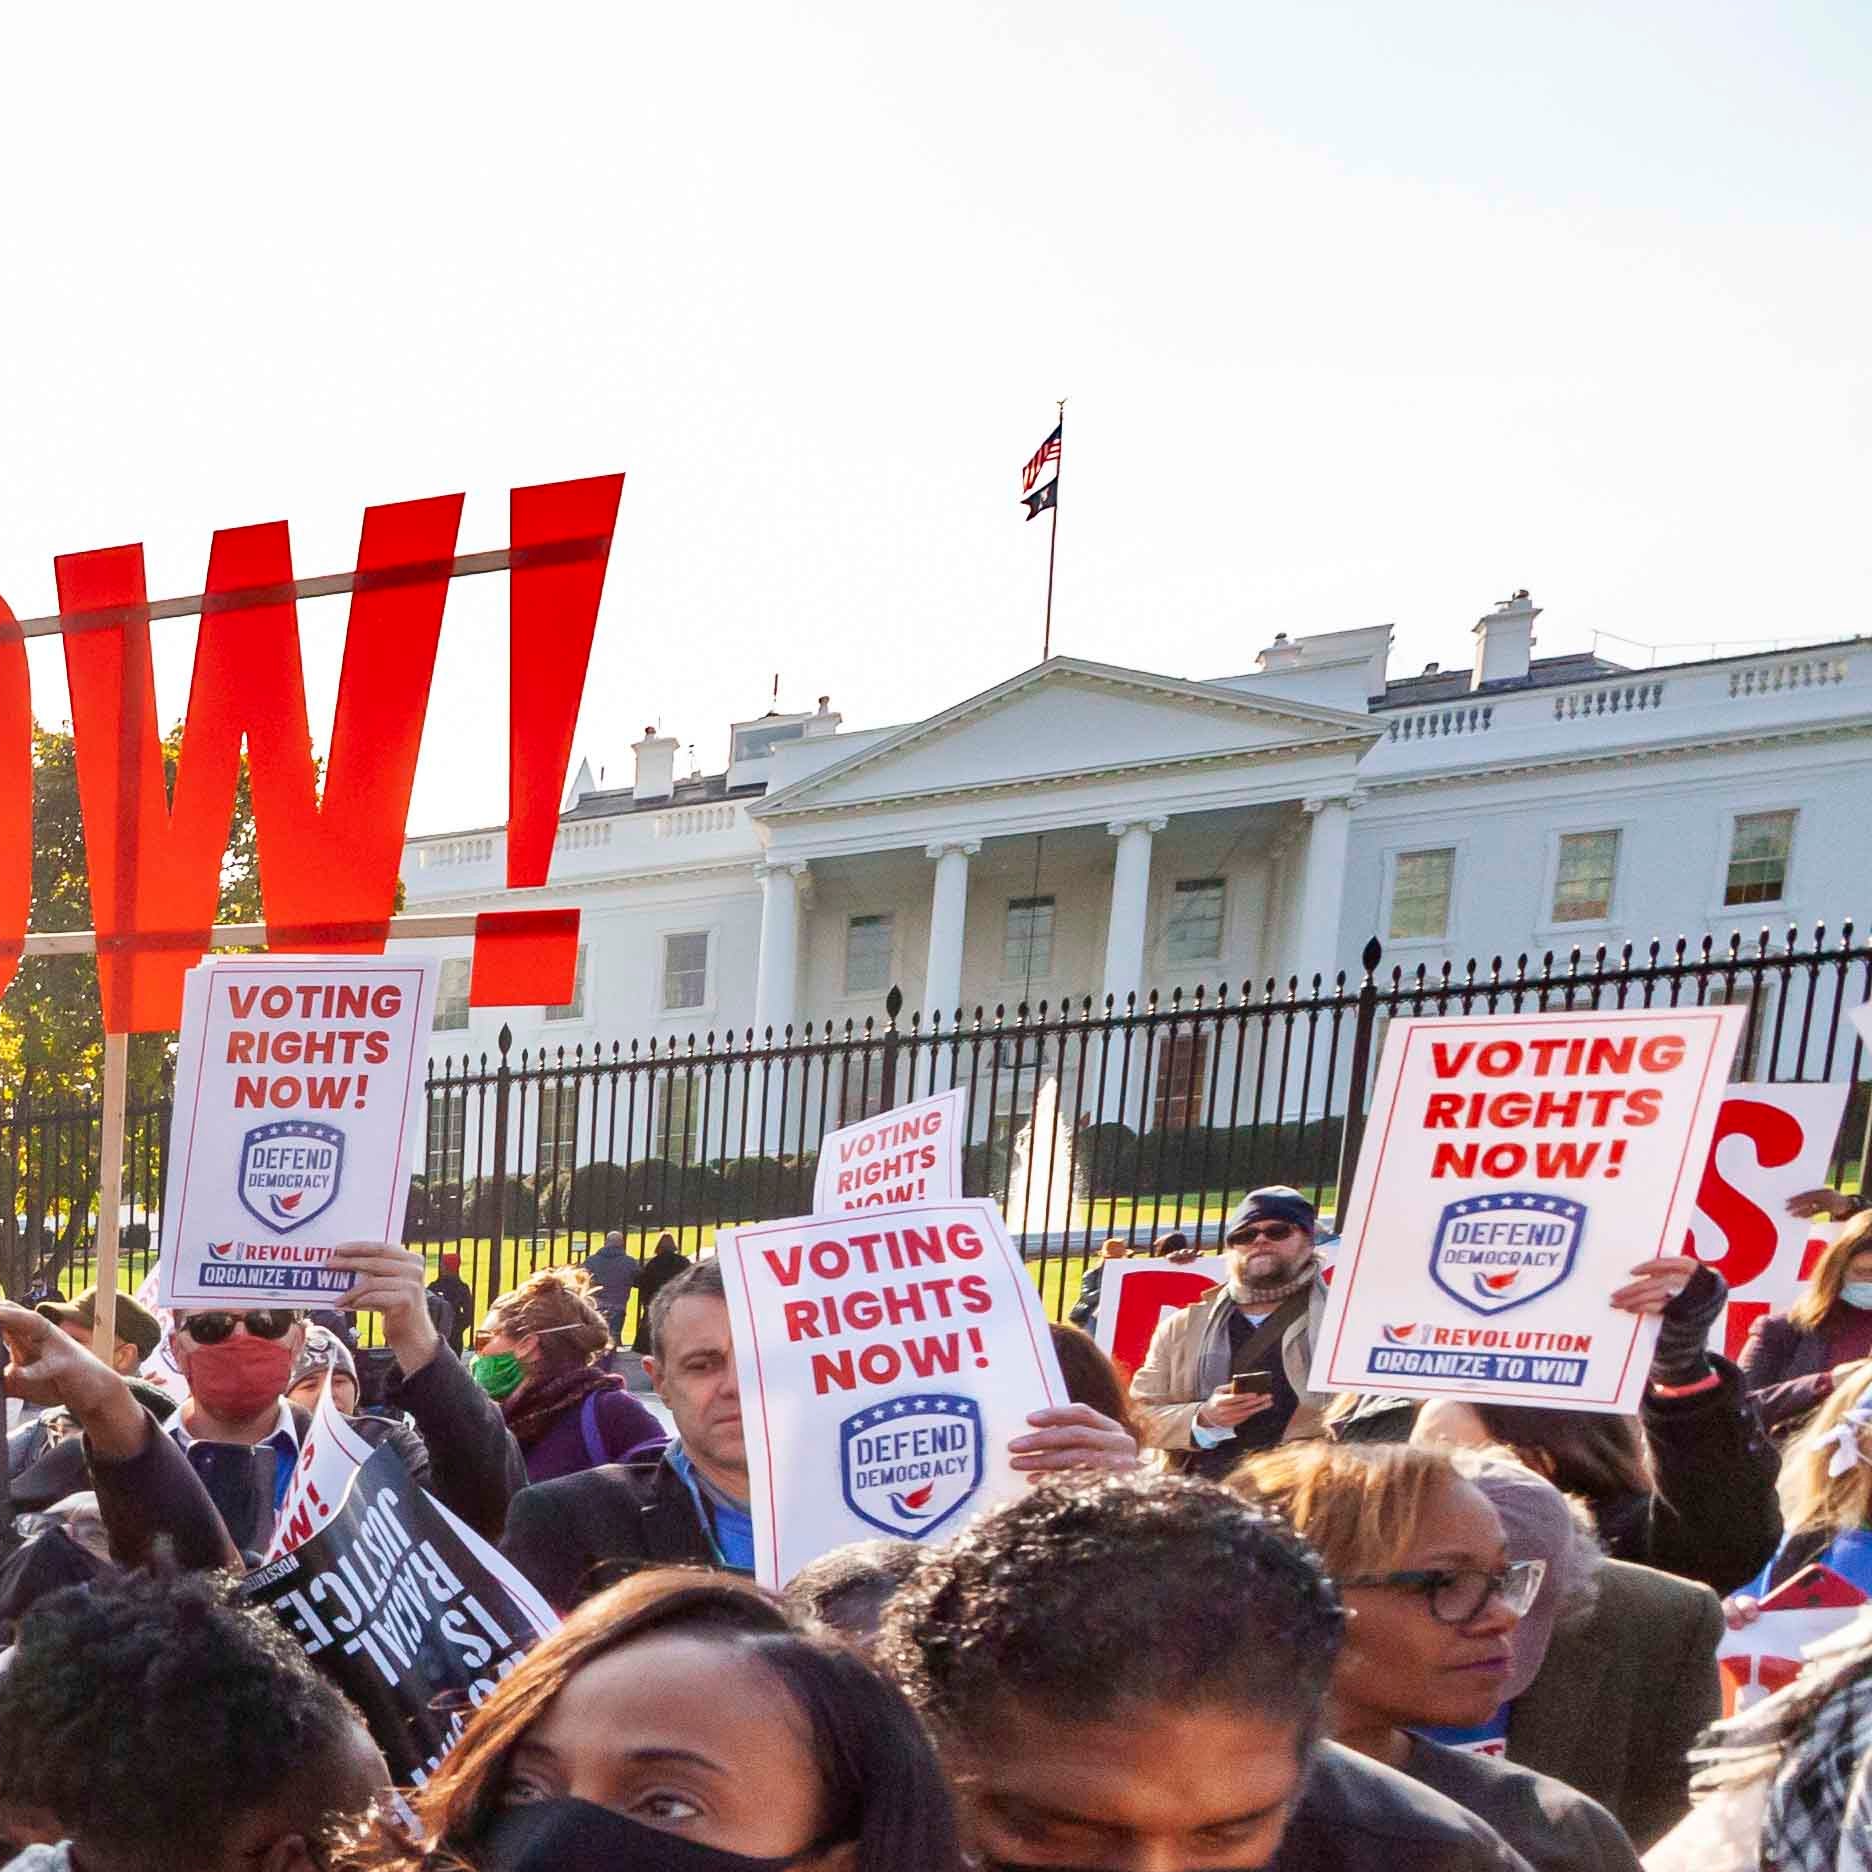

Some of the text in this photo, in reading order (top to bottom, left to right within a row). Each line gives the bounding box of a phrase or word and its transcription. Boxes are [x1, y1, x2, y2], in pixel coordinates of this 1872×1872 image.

[226, 984, 402, 1020] VOTING
[226, 1029, 389, 1065] RIGHTS
[1430, 1035, 1687, 1079] VOTING
[233, 1074, 369, 1111] NOW!
[1423, 1088, 1663, 1129] RIGHTS
[838, 1110, 943, 1164] VOTING
[251, 1145, 333, 1173] DEFEND
[836, 1144, 936, 1195] RIGHTS
[1430, 1139, 1628, 1181] NOW!
[248, 1171, 331, 1190] DEMOCRACY
[1451, 1218, 1566, 1247] DEFEND
[245, 1244, 336, 1262] REVOLUTI
[762, 1222, 984, 1287] VOTING
[1442, 1245, 1562, 1268] DEMOCRACY
[205, 1266, 351, 1290] ORGANIZE TO WIN
[783, 1274, 993, 1344] RIGHTS
[1434, 1327, 1593, 1353] REVOLUTION
[811, 1327, 990, 1397] NOW!
[1374, 1350, 1580, 1384] ORGANIZE TO WIN
[856, 1423, 968, 1466] DEFEND
[856, 1455, 969, 1490] DEMOCRACY
[274, 1487, 413, 1654] JUSTICE
[344, 1540, 464, 1687] RACIAL
[439, 1595, 512, 1668] IS
